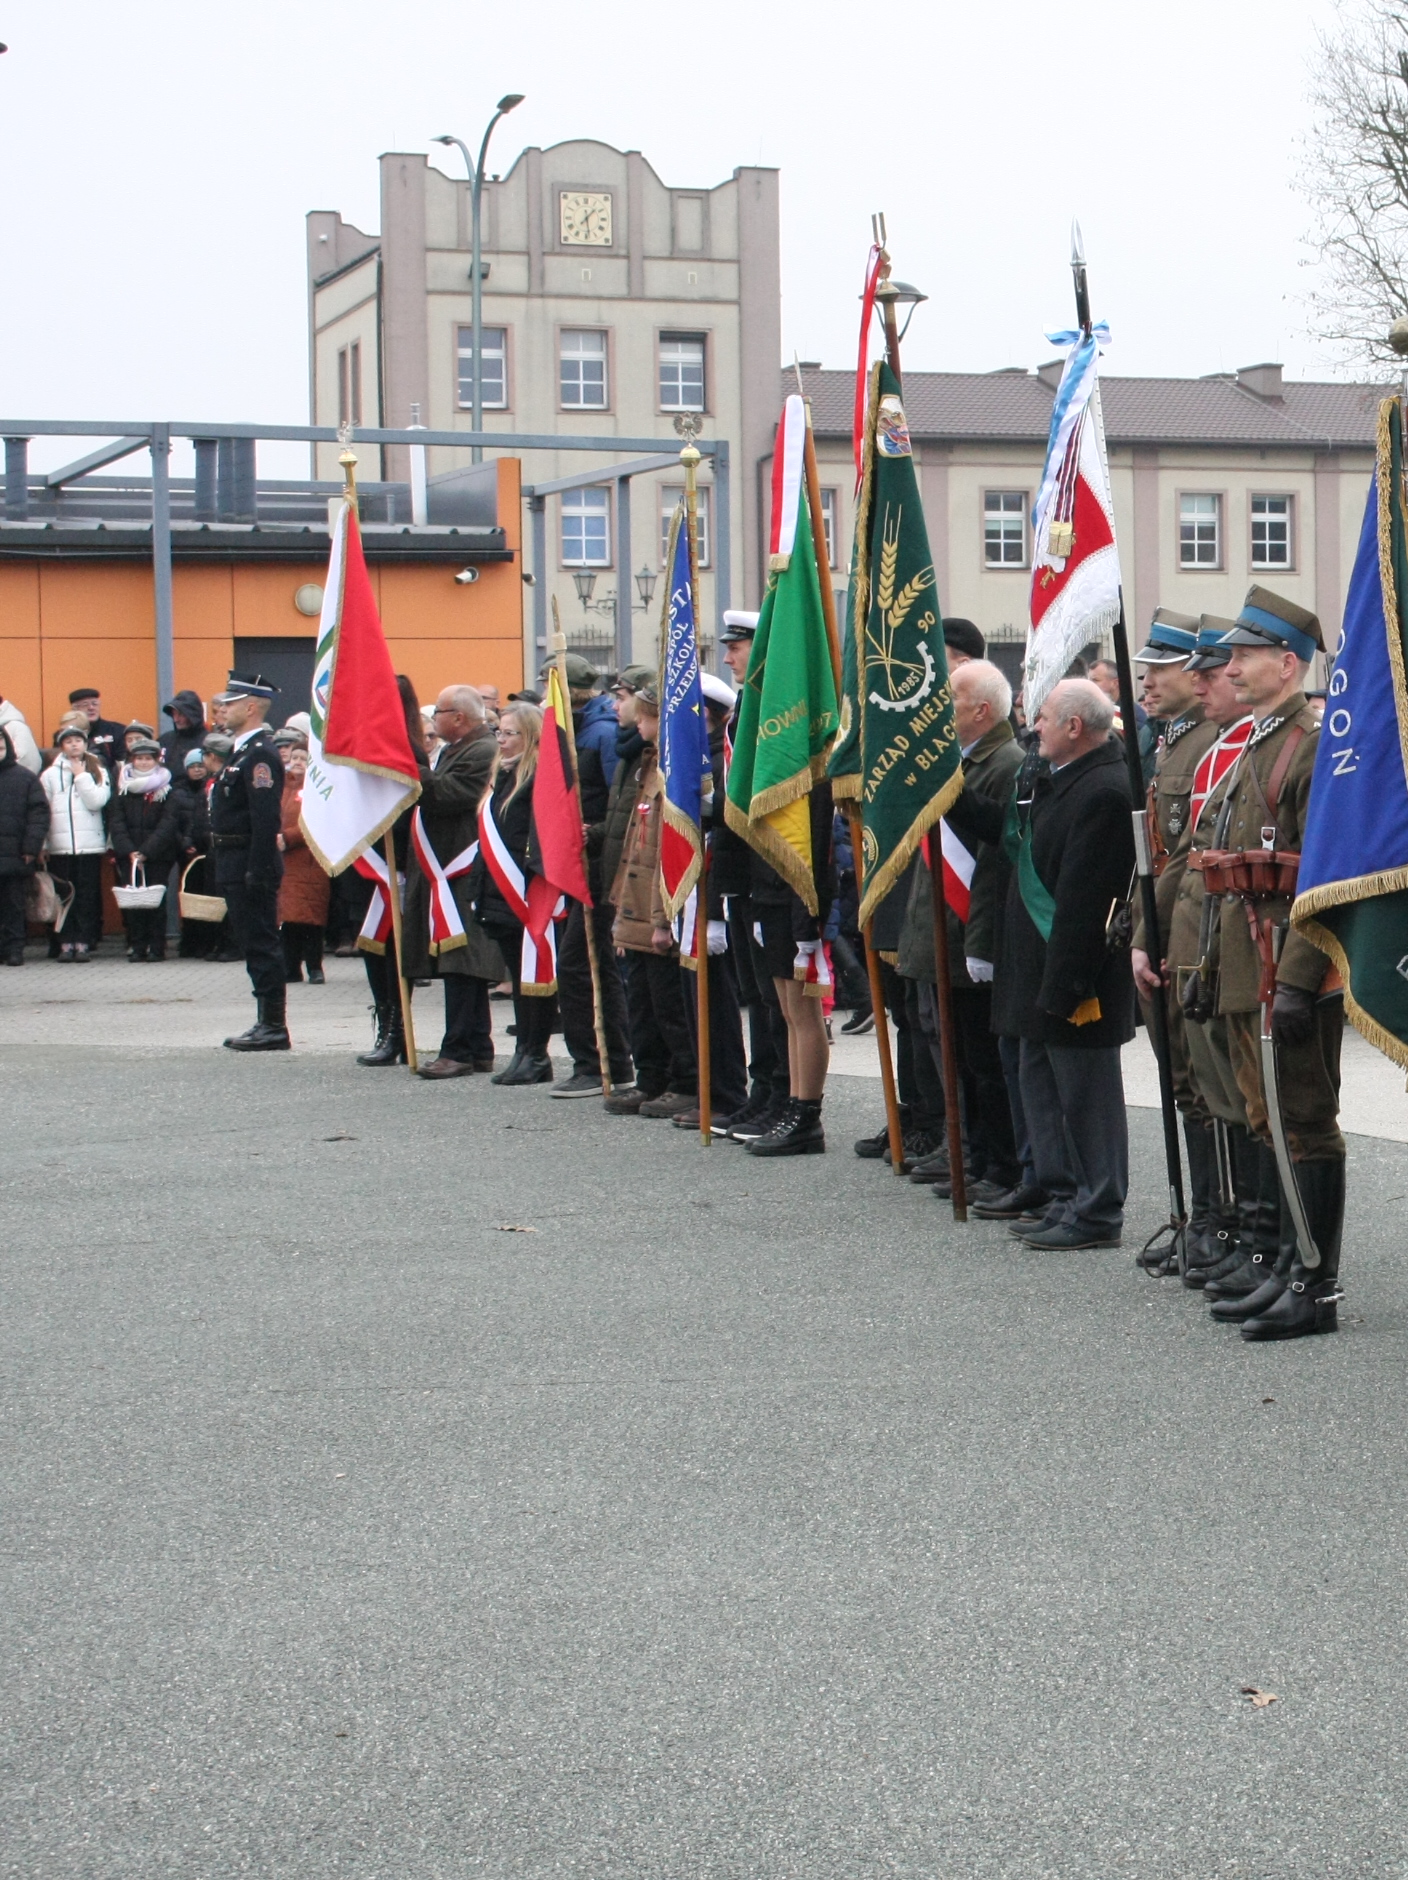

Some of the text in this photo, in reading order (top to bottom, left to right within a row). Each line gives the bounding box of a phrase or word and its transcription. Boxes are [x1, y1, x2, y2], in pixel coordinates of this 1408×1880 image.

[917, 611, 936, 634] 90
[898, 671, 920, 695] 1985
[864, 734, 910, 803] ZARZĄD
